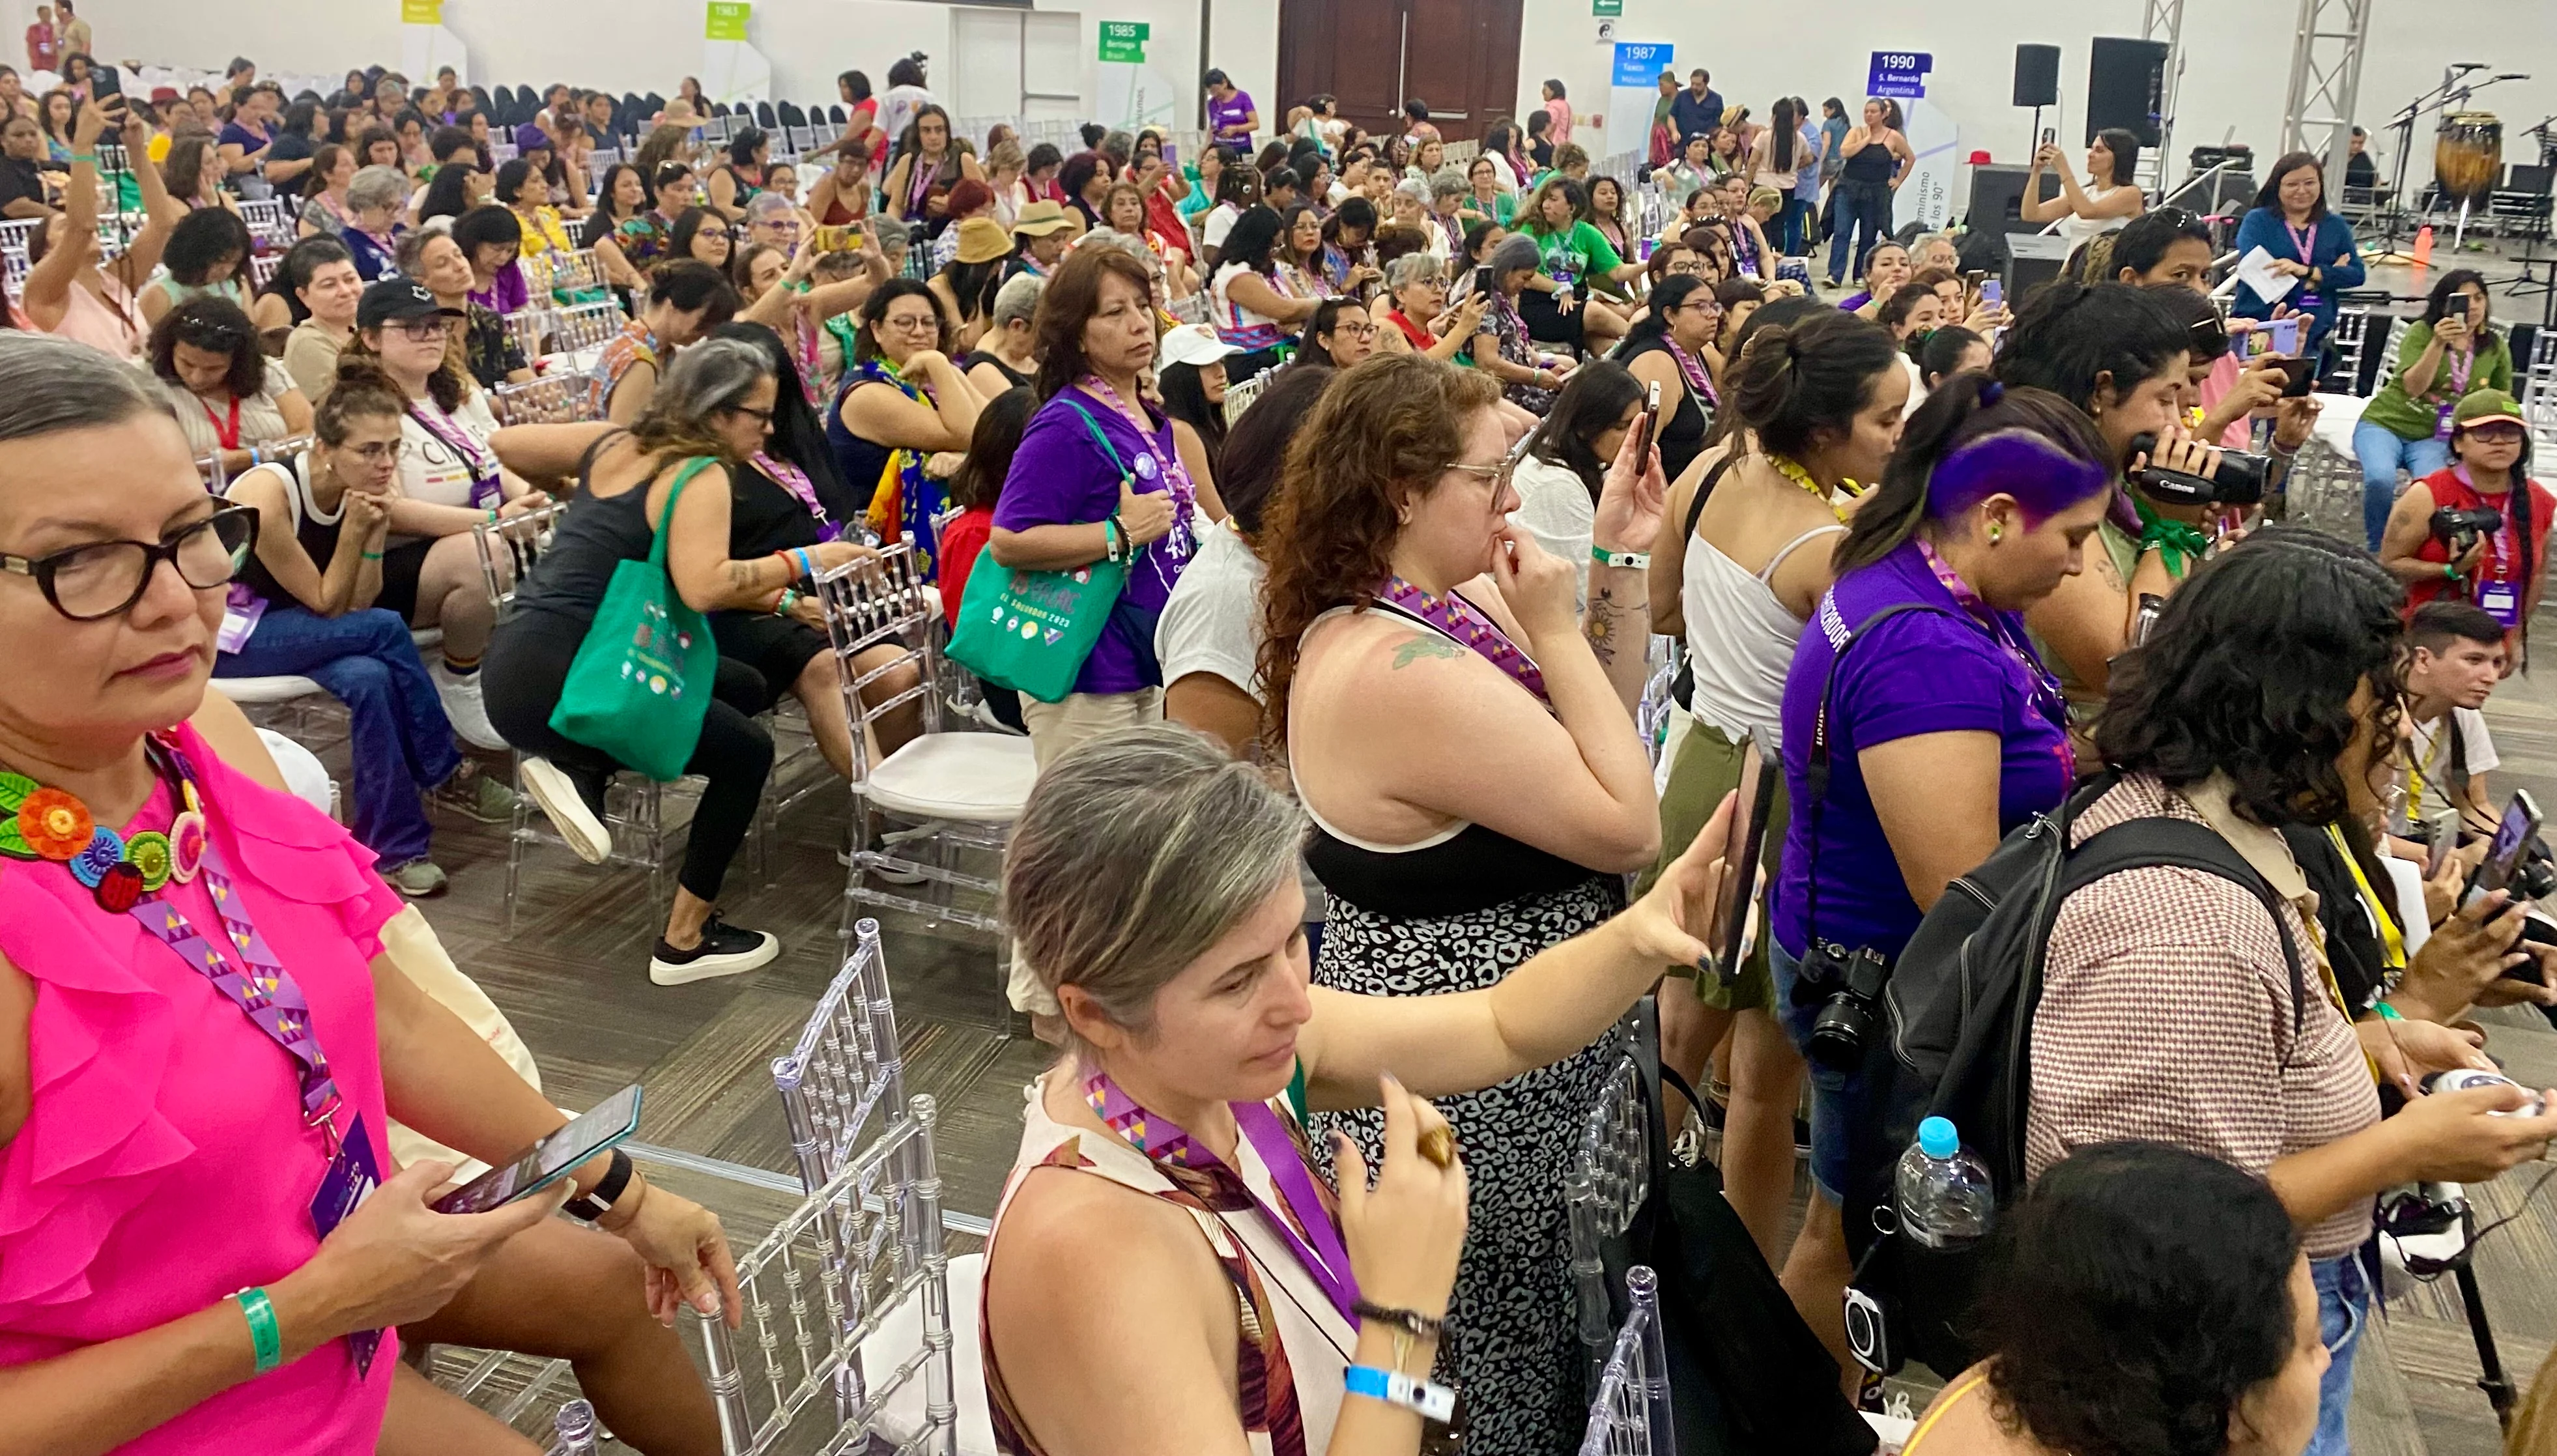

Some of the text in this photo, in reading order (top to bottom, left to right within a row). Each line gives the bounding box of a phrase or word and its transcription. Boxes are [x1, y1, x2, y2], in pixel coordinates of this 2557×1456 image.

[1108, 25, 1136, 36] 1985
[1625, 46, 1657, 59] 1987
[1623, 63, 1645, 72] Taxco
[1882, 55, 1915, 69] 1990
[1878, 73, 1919, 83] S. Bernardo
[1877, 85, 1915, 95] Argentina
[1915, 171, 1930, 223] eminismo
[1930, 204, 1941, 220] los
[2159, 479, 2195, 494] Canon
[1048, 613, 1070, 628] 2023
